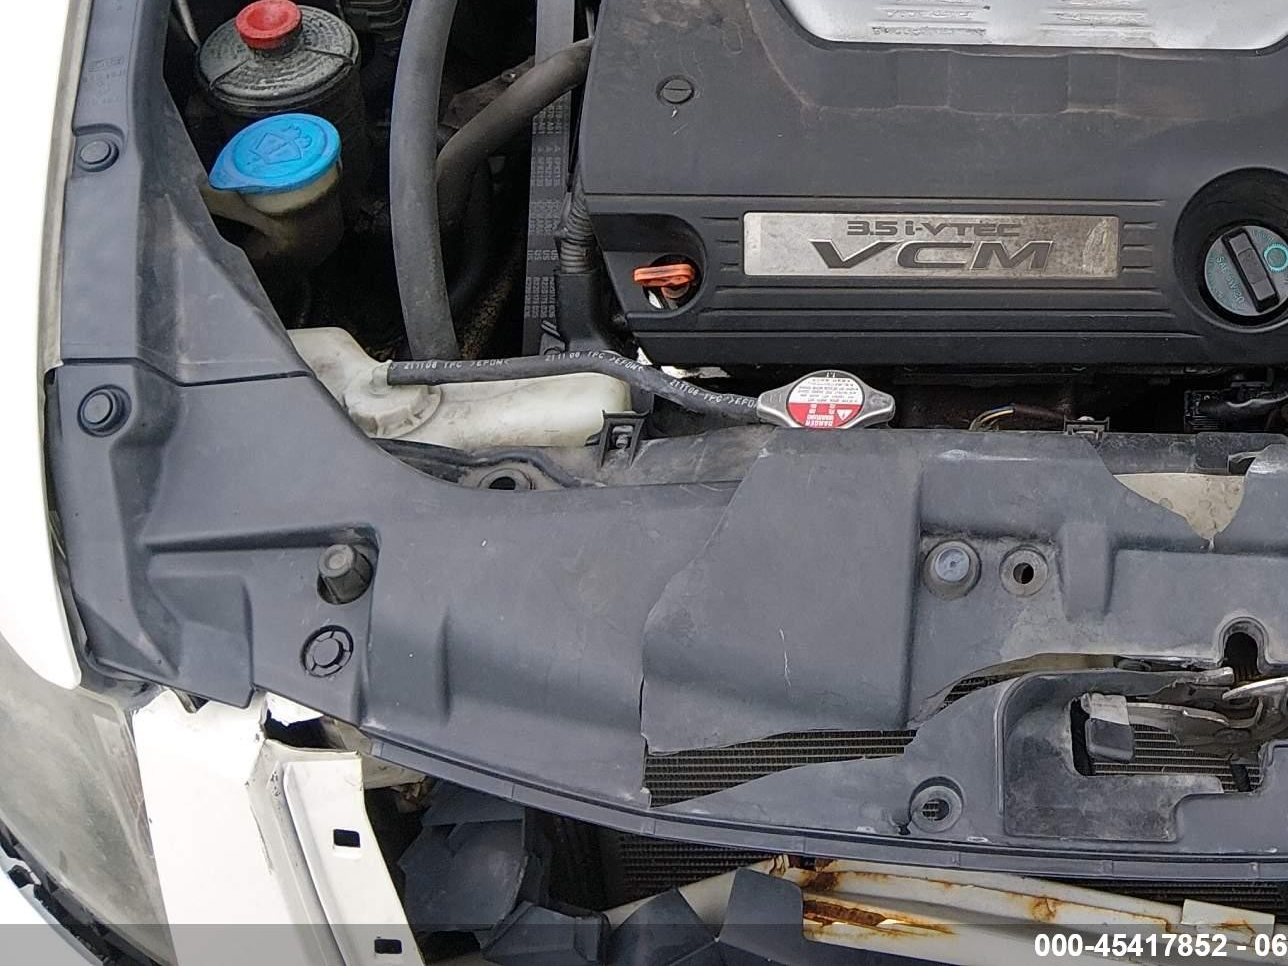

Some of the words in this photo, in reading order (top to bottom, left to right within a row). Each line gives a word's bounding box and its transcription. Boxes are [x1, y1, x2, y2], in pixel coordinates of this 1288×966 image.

[846, 220, 899, 236] 3.5
[905, 220, 1023, 236] i-VTEC
[809, 239, 1055, 271] VCM
